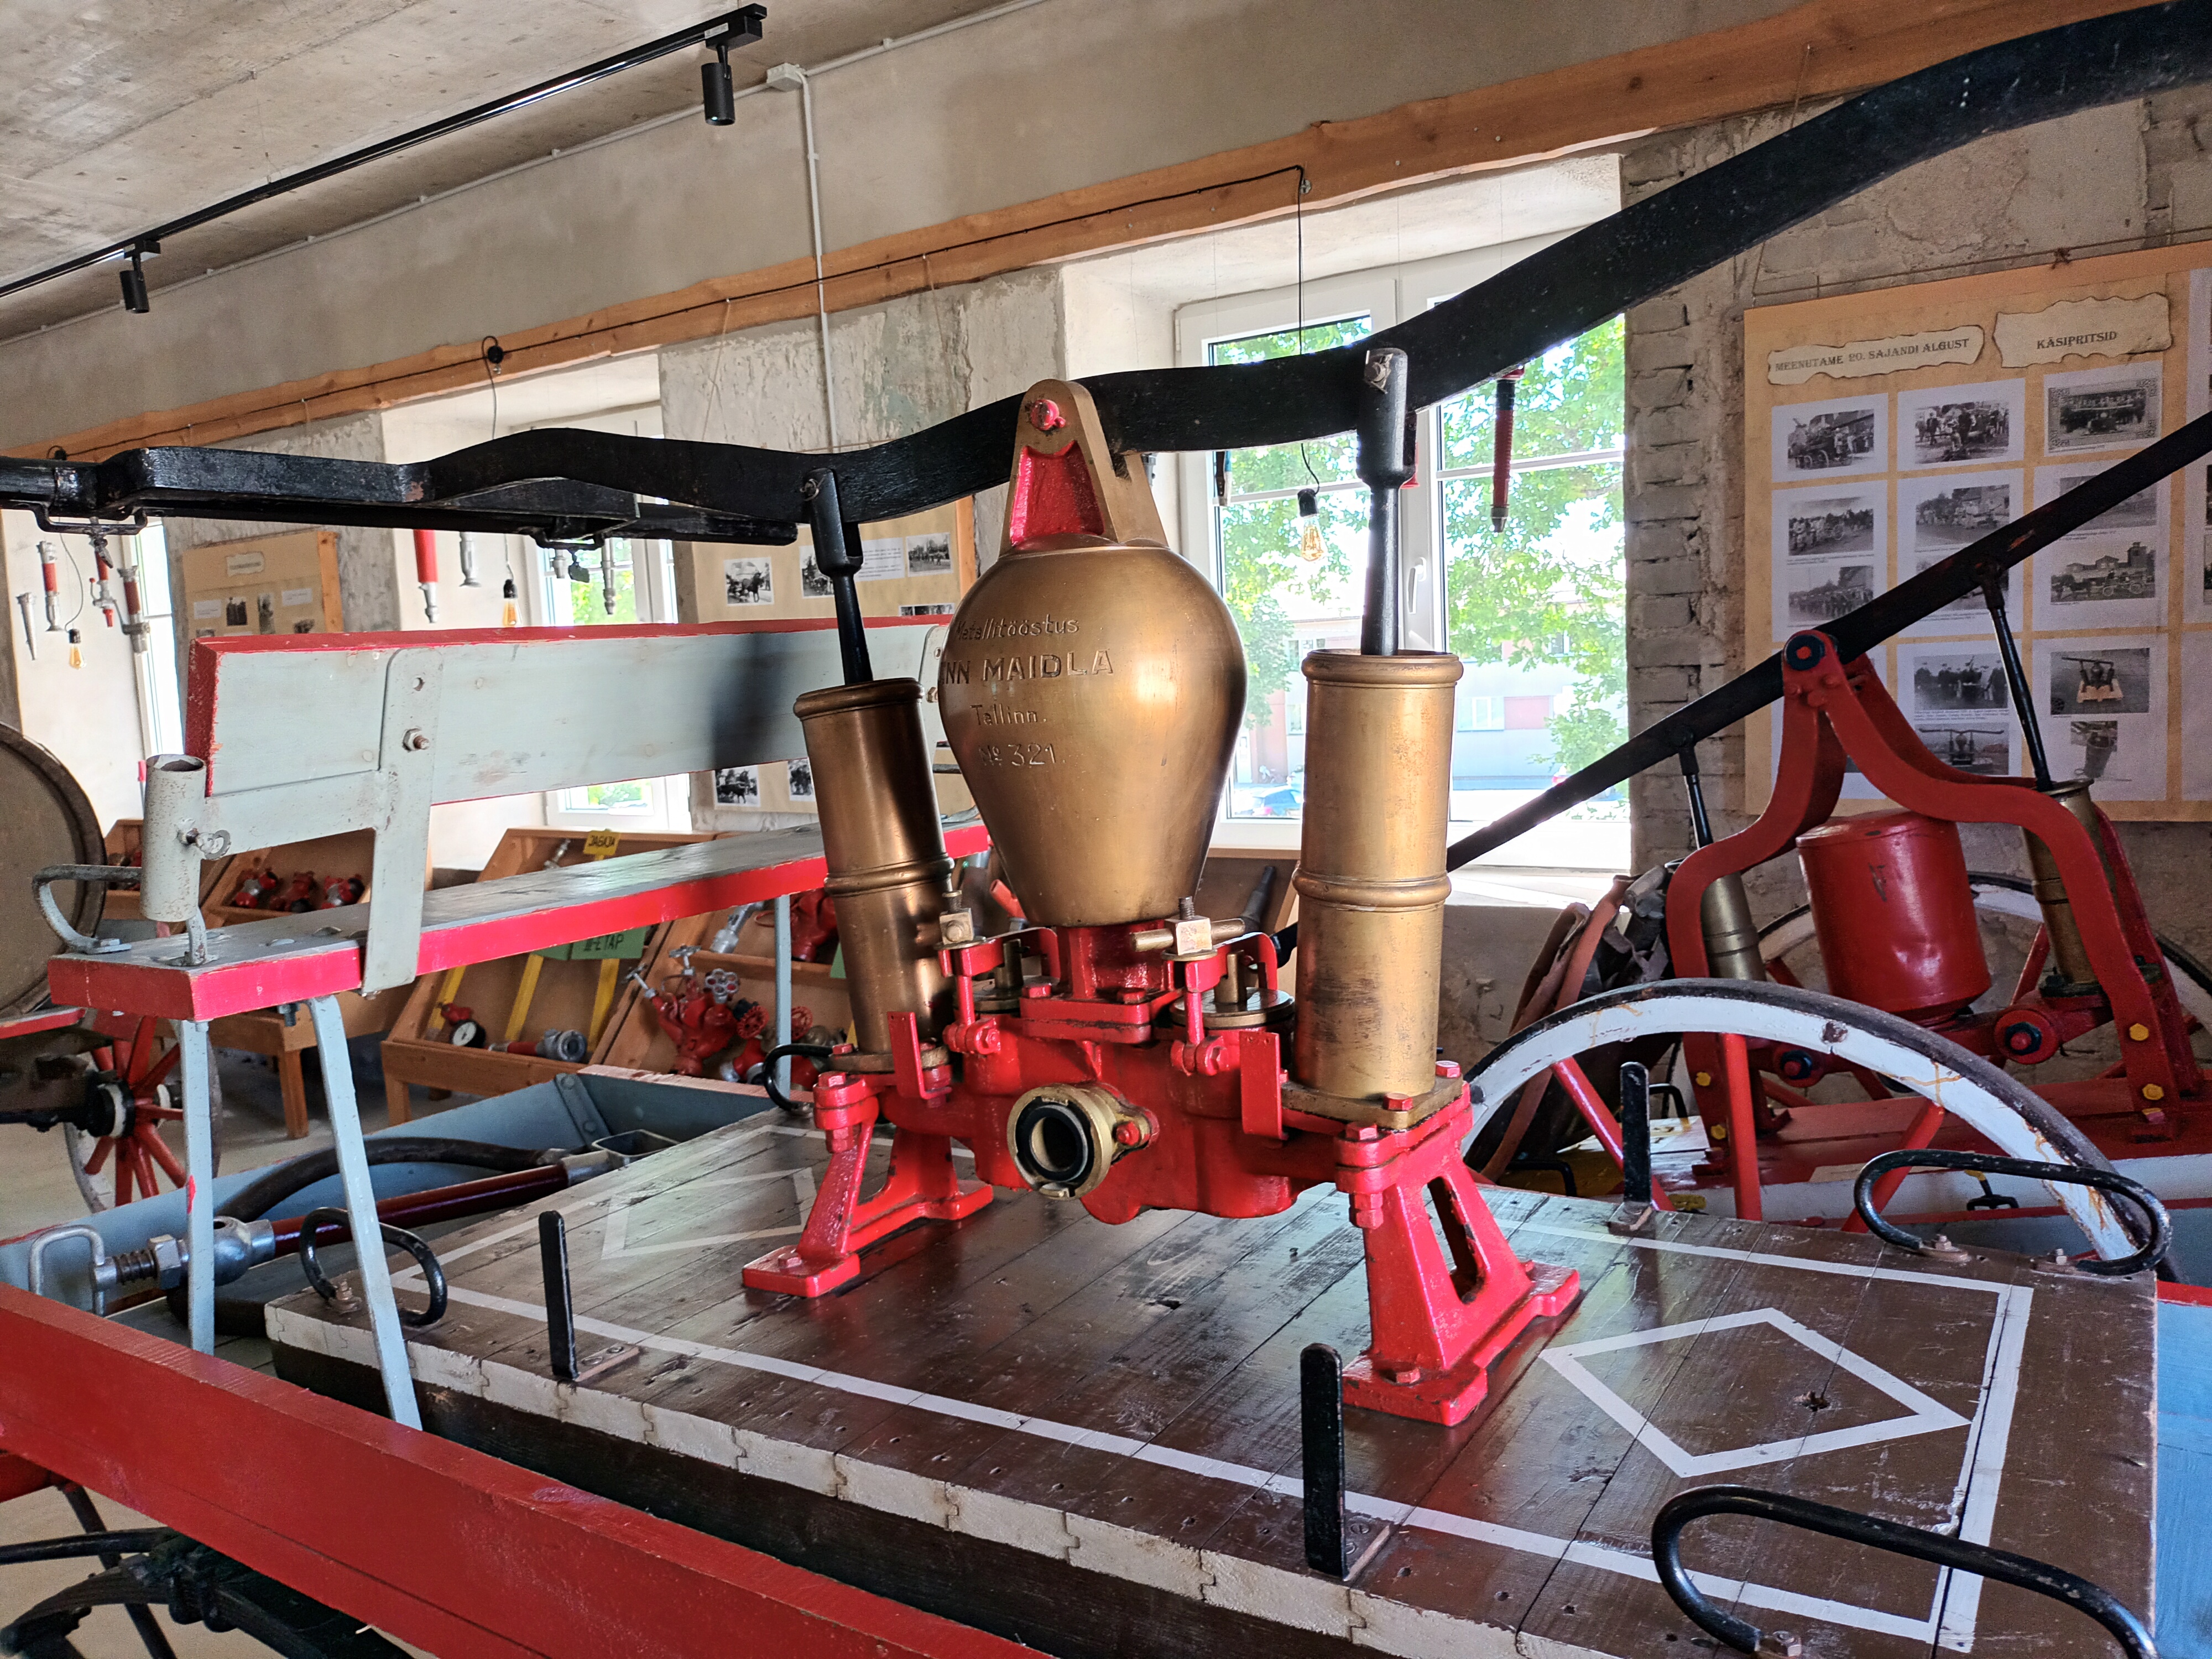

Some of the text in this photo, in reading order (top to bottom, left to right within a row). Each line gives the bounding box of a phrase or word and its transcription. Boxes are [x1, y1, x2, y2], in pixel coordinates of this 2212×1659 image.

[1775, 356, 1844, 372] MEENUTAME
[1869, 345, 1919, 360] SAJANDI
[1922, 338, 1970, 353] ALGUST
[2037, 331, 2117, 349] KÄSIPRITSID
[982, 649, 1114, 681] MAIDLA
